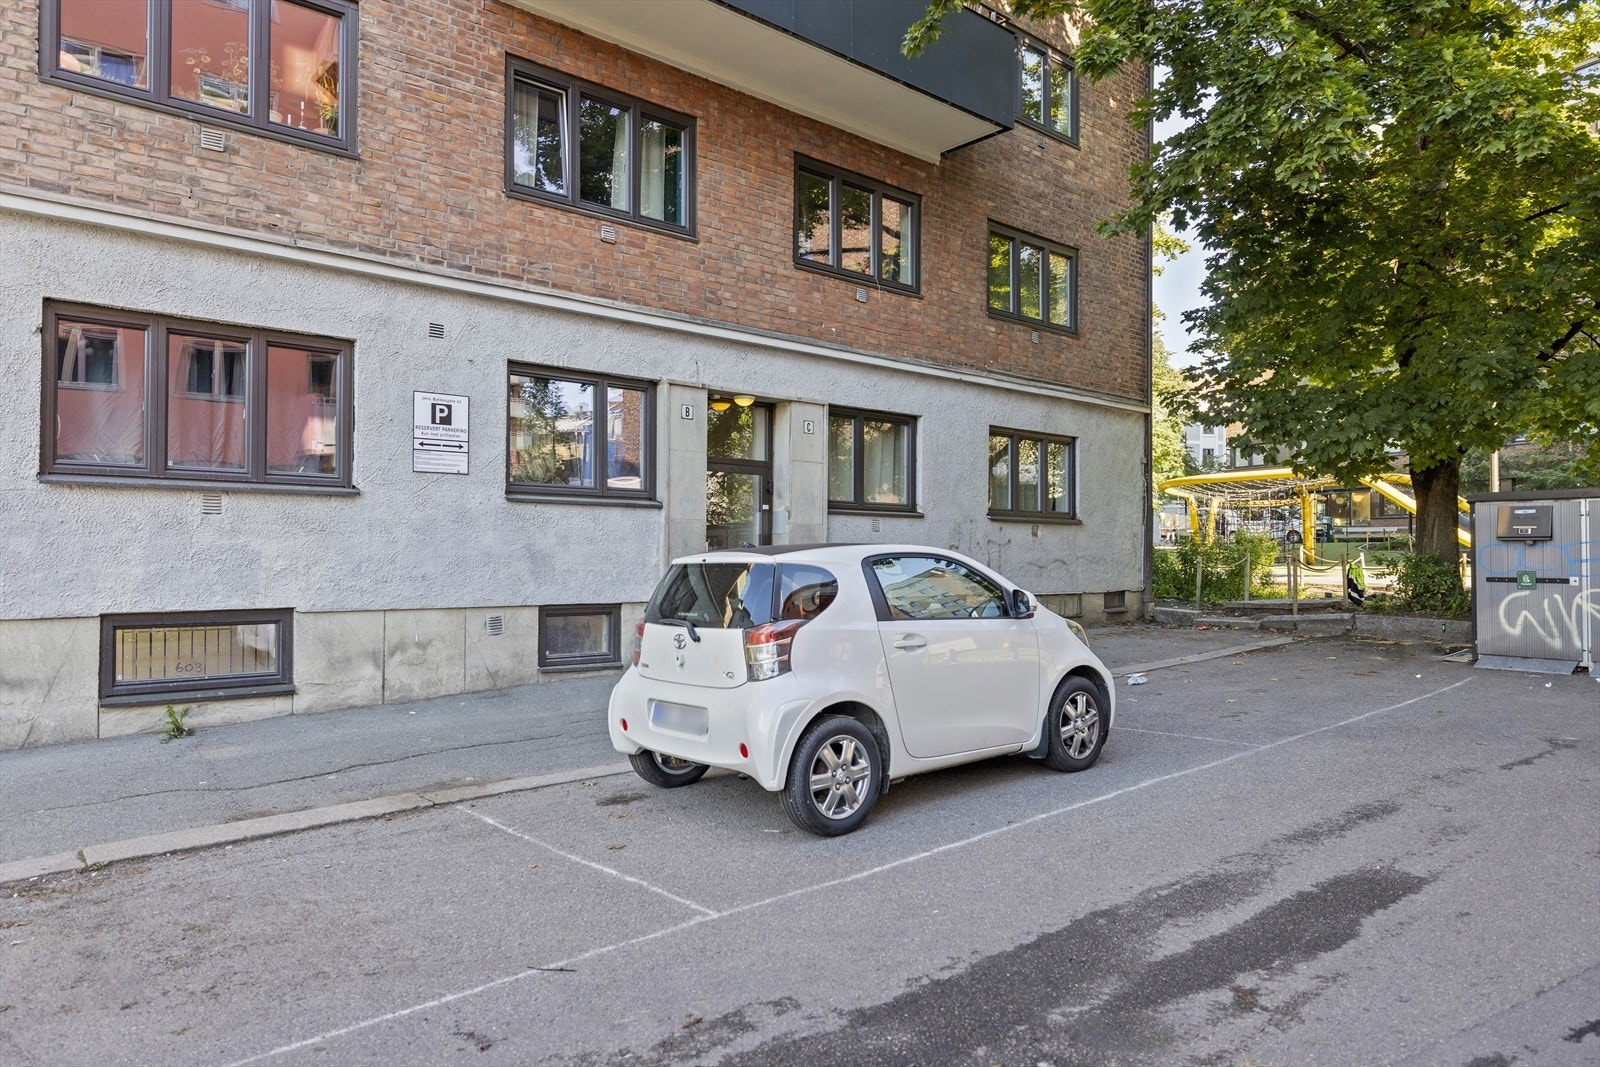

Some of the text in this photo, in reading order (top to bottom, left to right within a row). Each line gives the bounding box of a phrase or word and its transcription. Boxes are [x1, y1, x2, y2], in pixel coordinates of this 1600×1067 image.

[435, 404, 449, 424] P
[685, 406, 690, 418] B
[806, 422, 812, 433] C
[175, 661, 203, 673] 603
